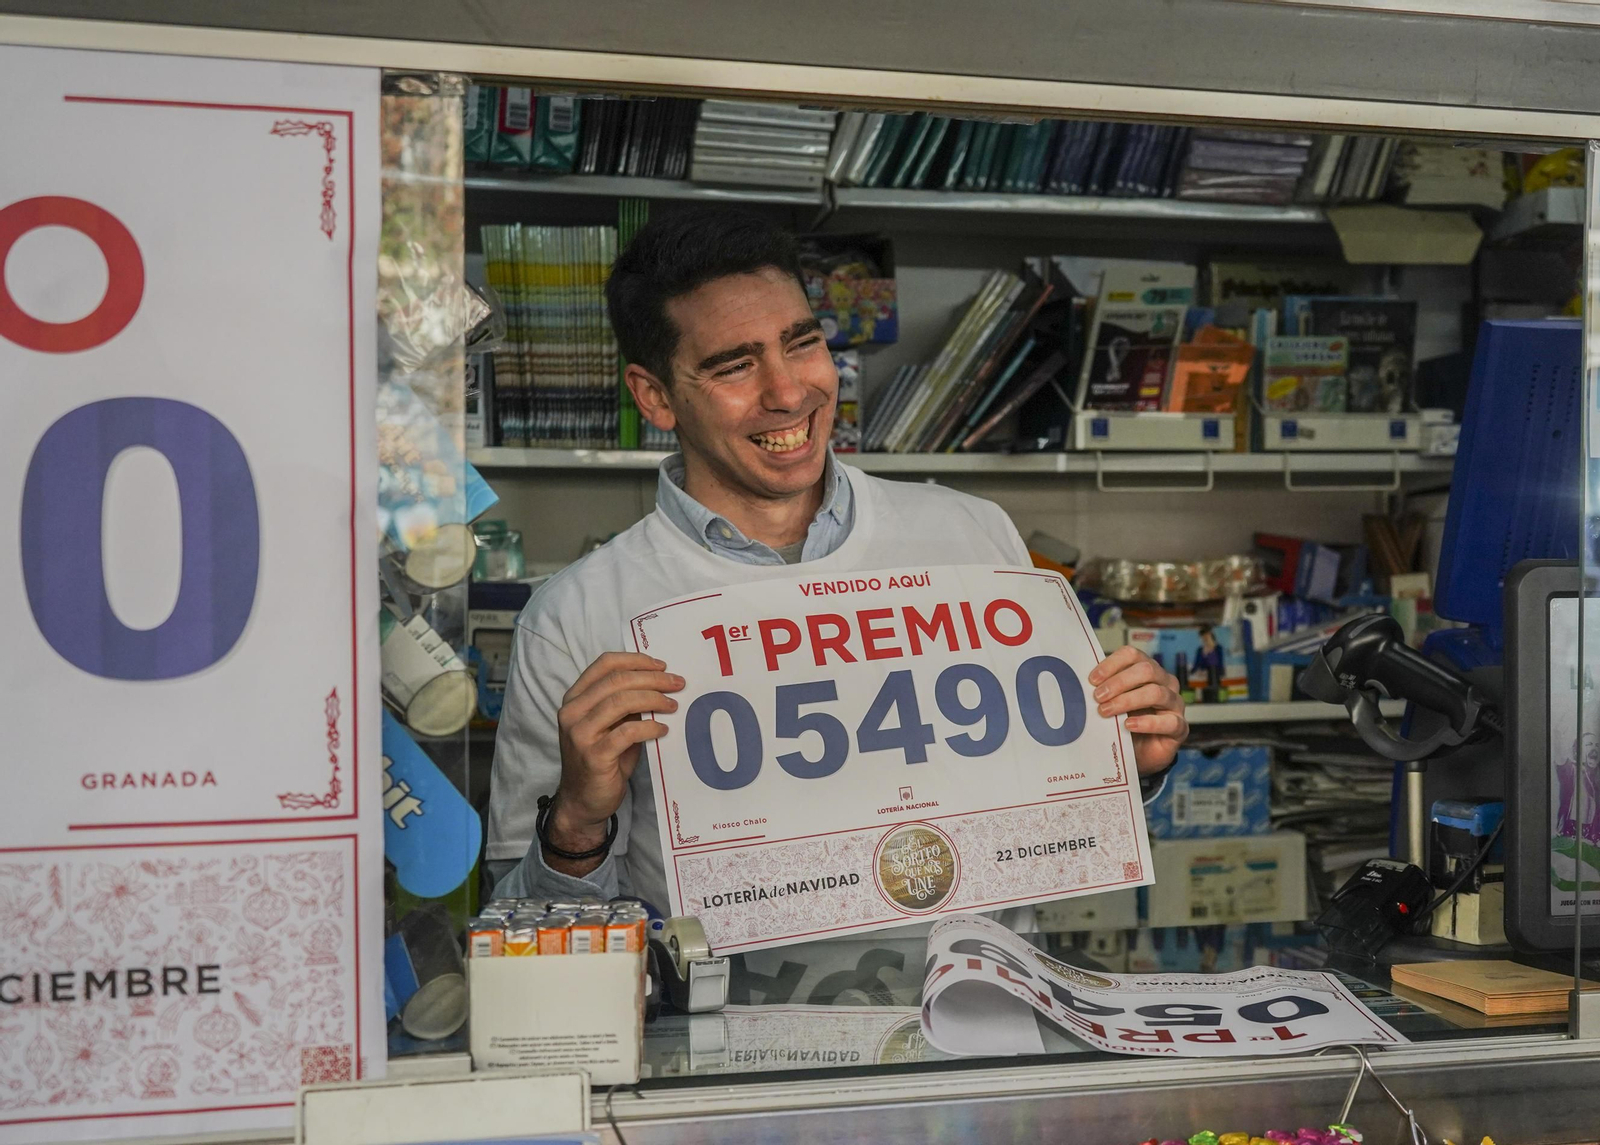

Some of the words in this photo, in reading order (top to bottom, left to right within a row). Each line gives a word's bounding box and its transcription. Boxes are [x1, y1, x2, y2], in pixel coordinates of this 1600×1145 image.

[799, 578, 882, 597] VENDIDO
[888, 571, 931, 589] AQUÍ
[758, 597, 1033, 672] PREMIO
[684, 654, 1088, 791] 05490
[80, 770, 218, 791] GRANADA
[1047, 772, 1086, 784] GRANADA
[877, 804, 904, 815] LOTERÍA
[905, 800, 940, 811] NACIONAL
[712, 820, 741, 831] Kiosco
[743, 816, 768, 827] Chalo
[891, 844, 941, 876] SORTEO
[996, 849, 1013, 862] 22
[1018, 836, 1097, 859] DICIEMBRE
[904, 866, 923, 877] QUE
[924, 859, 943, 875] NOS
[902, 875, 936, 901] UNE
